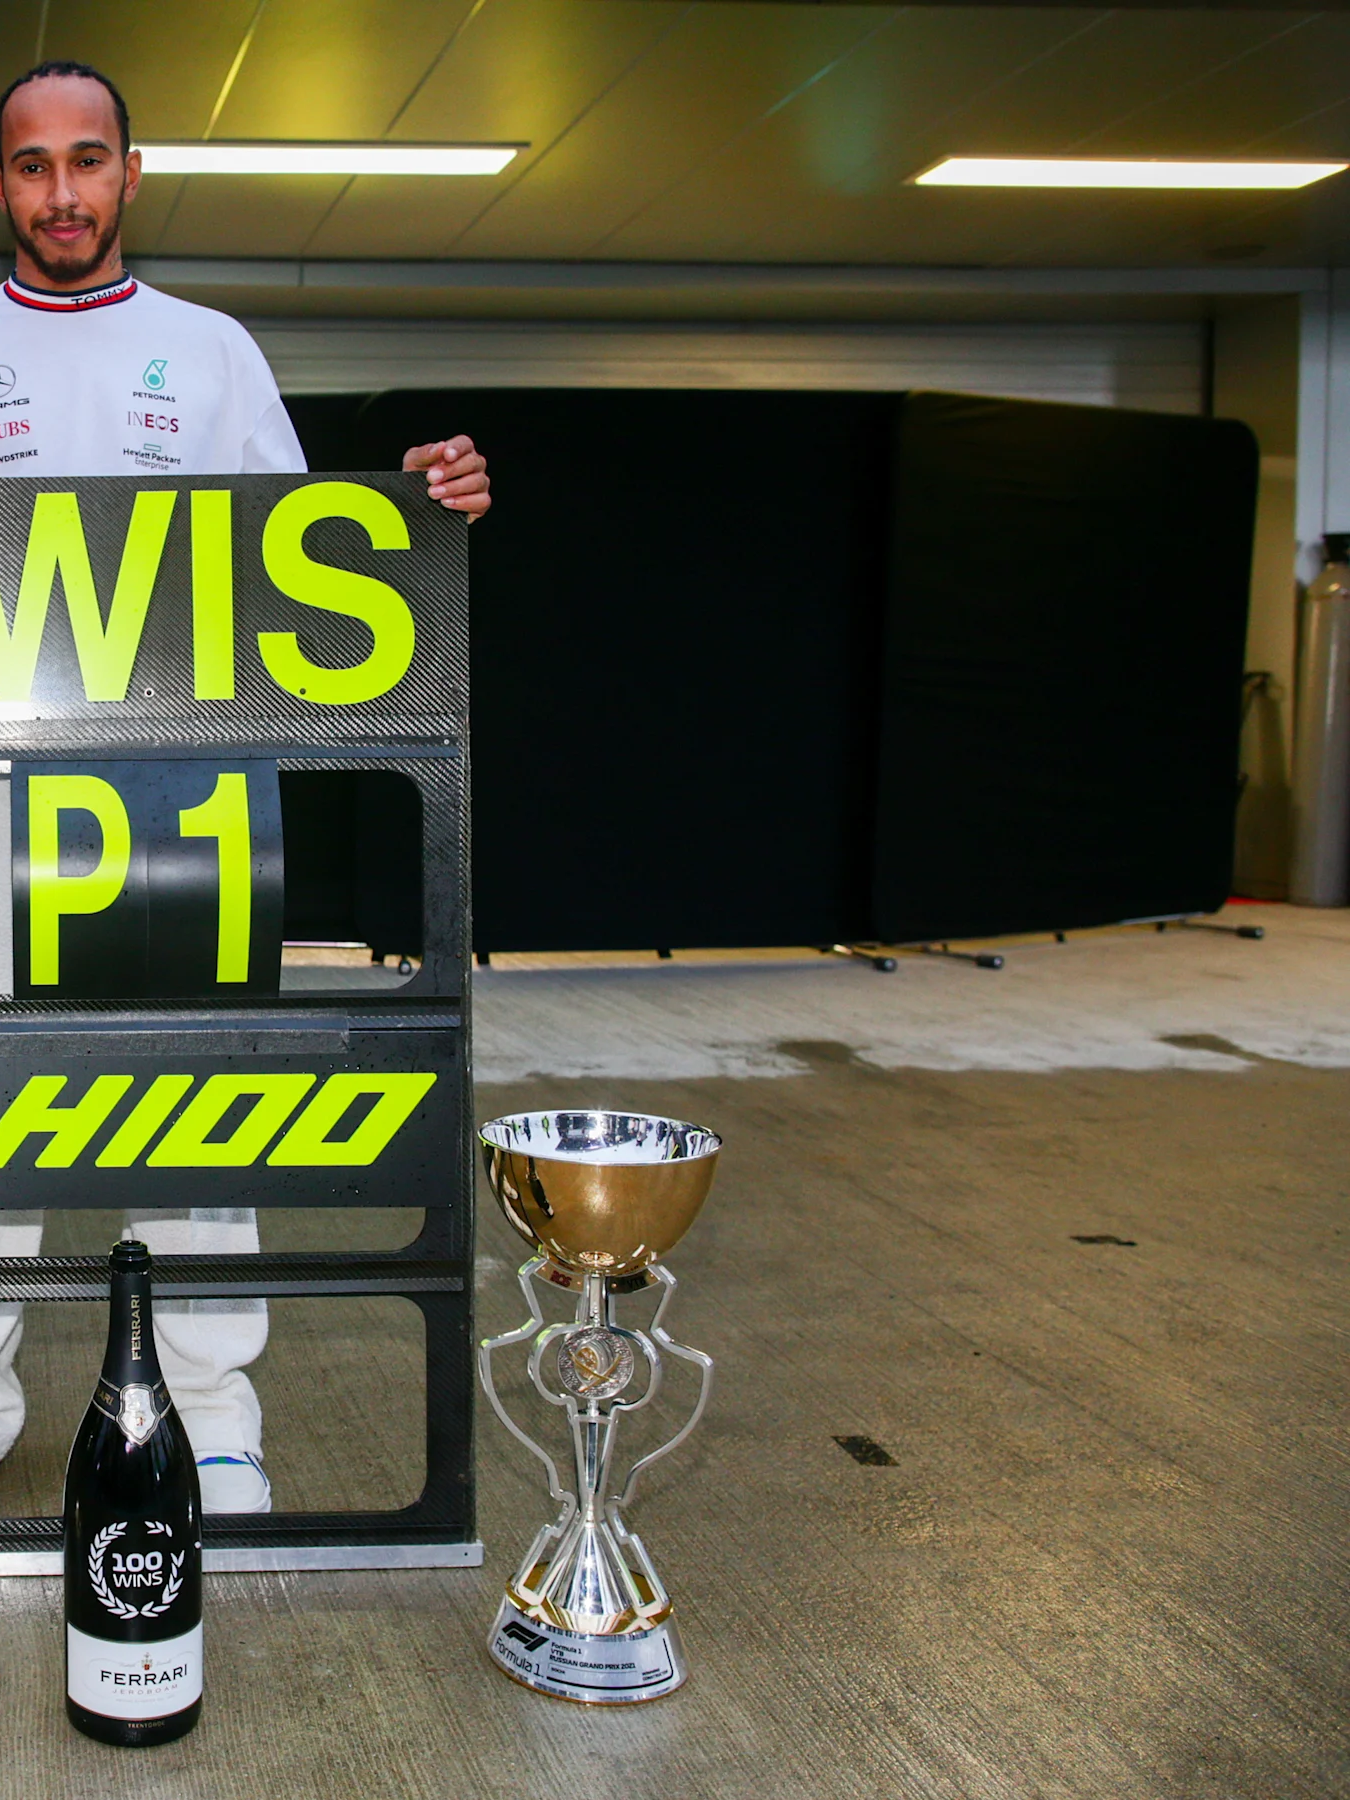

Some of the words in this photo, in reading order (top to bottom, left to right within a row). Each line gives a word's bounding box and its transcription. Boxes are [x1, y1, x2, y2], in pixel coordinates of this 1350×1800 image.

[71, 285, 125, 308] TOMMY
[132, 391, 176, 403] PETRONAS
[127, 411, 179, 433] INEOS
[123, 448, 150, 460] Hewlett
[151, 452, 181, 465] Packard
[134, 457, 169, 470] Enterprise
[131, 1294, 142, 1361] FERRARI
[112, 1551, 163, 1572] 100
[112, 1571, 163, 1588] WINS
[551, 1642, 576, 1653] Formula
[551, 1649, 564, 1657] VTB
[495, 1637, 532, 1675] Formula
[533, 1663, 541, 1677] 1
[549, 1655, 578, 1667] RUSSIAN
[579, 1661, 604, 1669] GRAND
[101, 1664, 187, 1686] FERRARI
[112, 1684, 178, 1695] JEROBOAM
